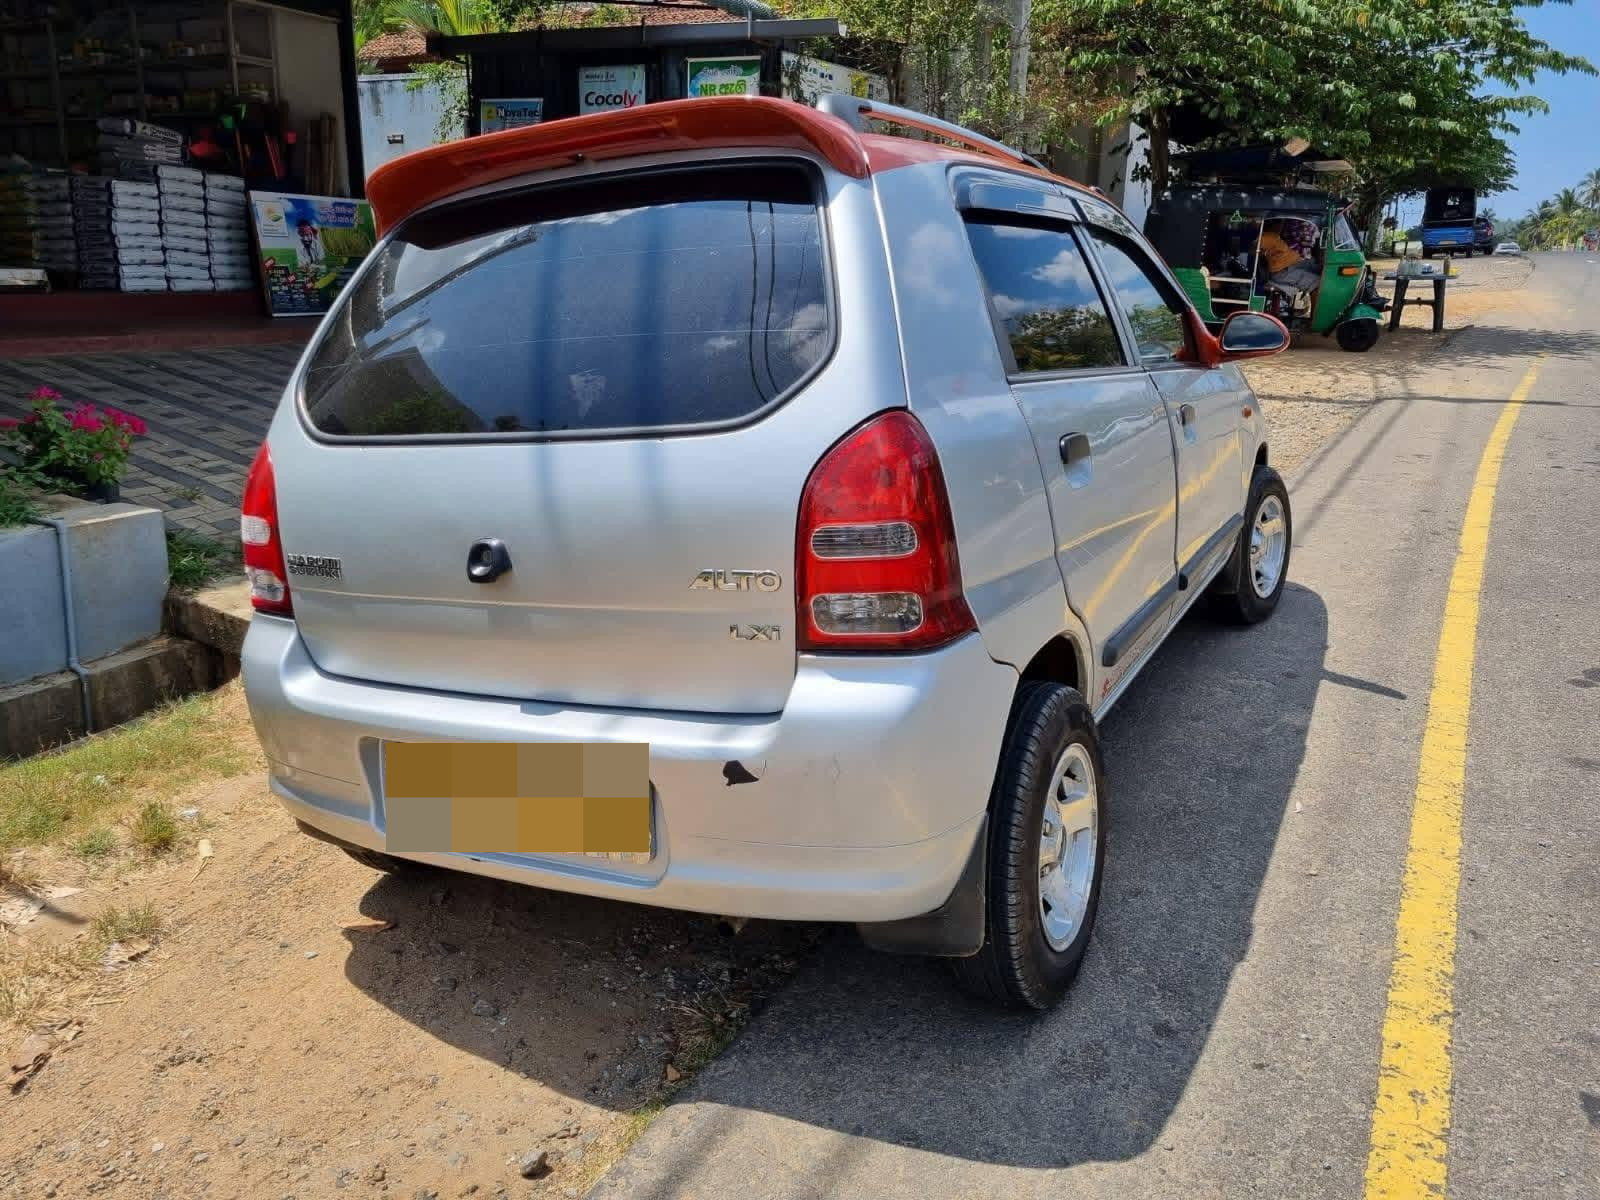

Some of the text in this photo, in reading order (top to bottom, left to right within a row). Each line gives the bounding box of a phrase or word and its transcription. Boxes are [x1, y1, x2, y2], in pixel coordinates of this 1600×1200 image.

[584, 88, 638, 108] Cocoly
[288, 565, 342, 580] SUZUKI
[688, 568, 782, 592] ALTO
